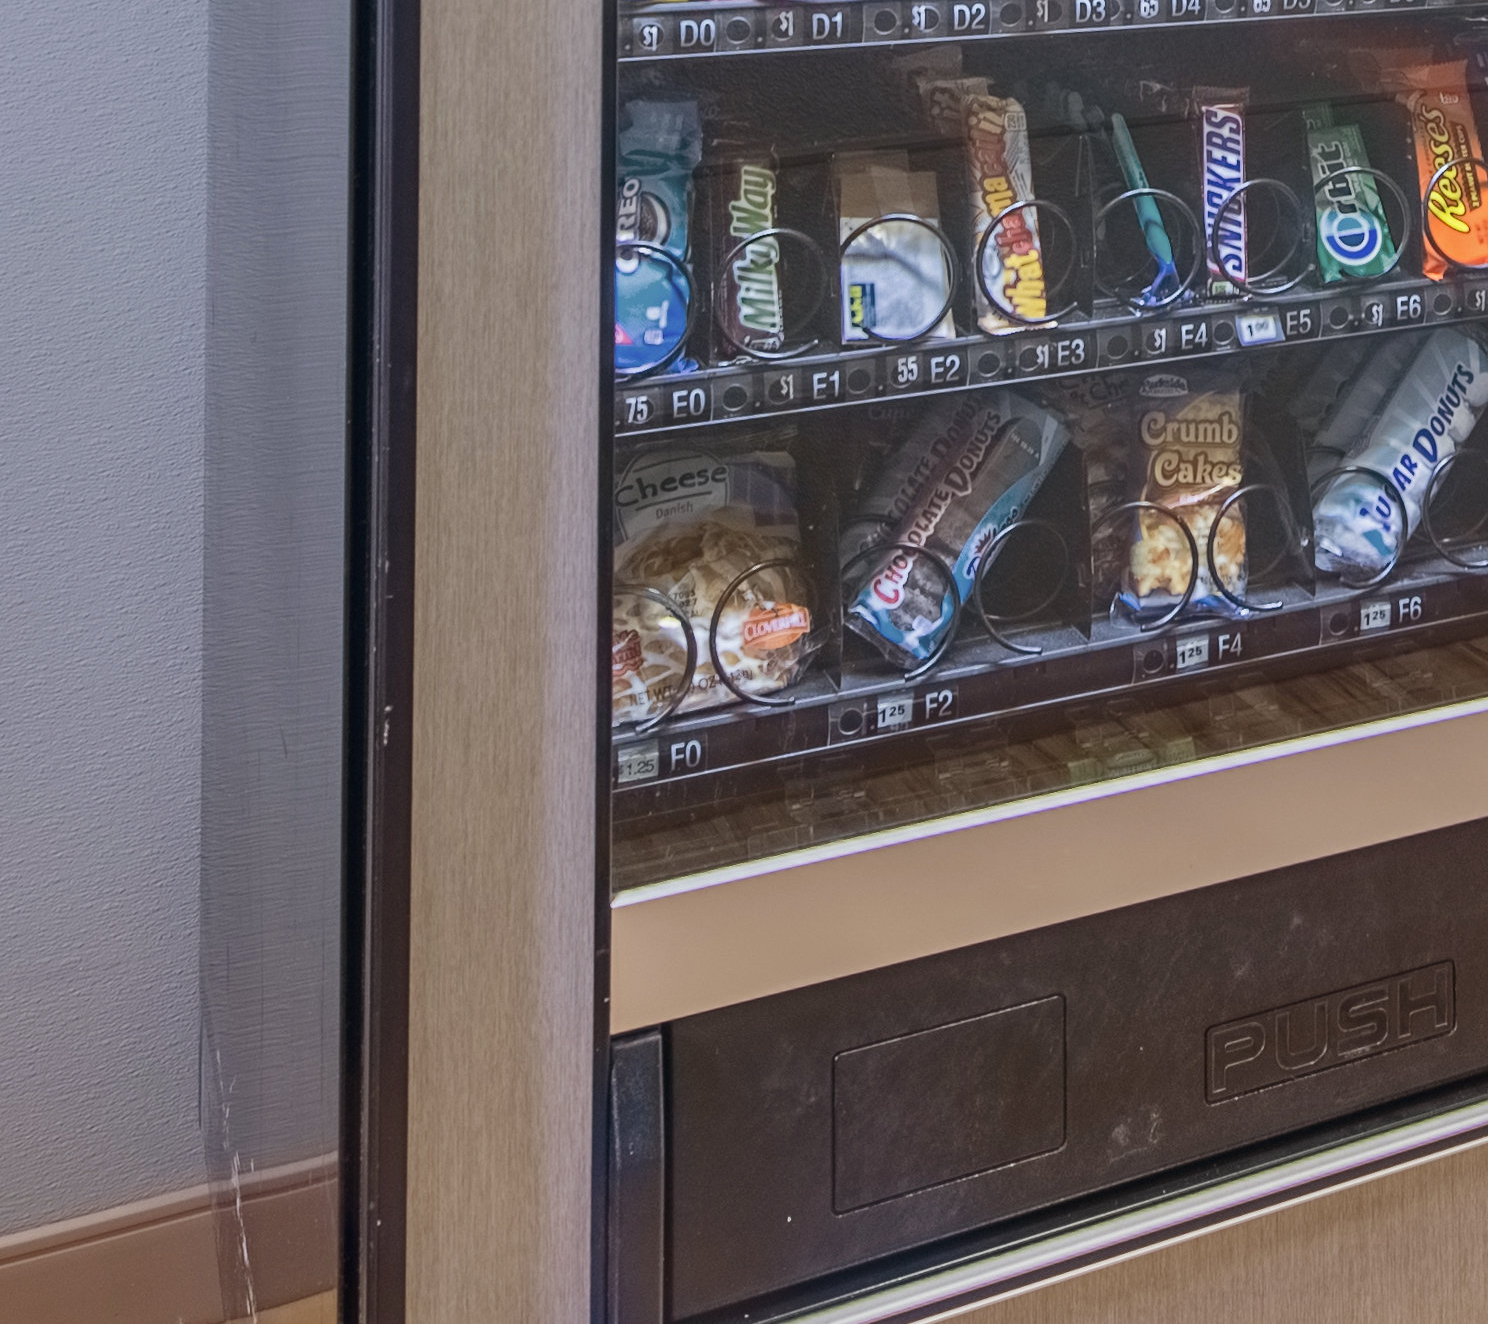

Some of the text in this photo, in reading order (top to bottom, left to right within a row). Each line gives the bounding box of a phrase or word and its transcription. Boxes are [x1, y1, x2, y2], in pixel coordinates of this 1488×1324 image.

[680, 19, 716, 47] D0
[813, 11, 844, 41] D1
[953, 3, 987, 31] D2
[1426, 104, 1470, 234] Reese's
[1205, 108, 1243, 274] SNICKERS
[1314, 139, 1382, 265] Orbit
[728, 165, 780, 334] Milky Way
[1286, 308, 1311, 336] E5
[1396, 295, 1422, 321] E6
[1180, 322, 1209, 350] E4
[1057, 339, 1085, 366] E3
[812, 369, 841, 401] E1
[930, 355, 961, 383] E2
[672, 387, 706, 420] E0
[1413, 362, 1475, 464] DONUTS
[1141, 409, 1240, 447] Crumb
[945, 410, 1002, 497] DONUTS
[1154, 450, 1244, 487] Cakes
[615, 462, 729, 508] Cheese
[655, 501, 695, 520] Danish
[1398, 596, 1423, 622] F6
[1218, 632, 1244, 660] F4
[925, 690, 954, 720] F2
[670, 738, 702, 770] F0
[1211, 966, 1450, 1095] PUSH
